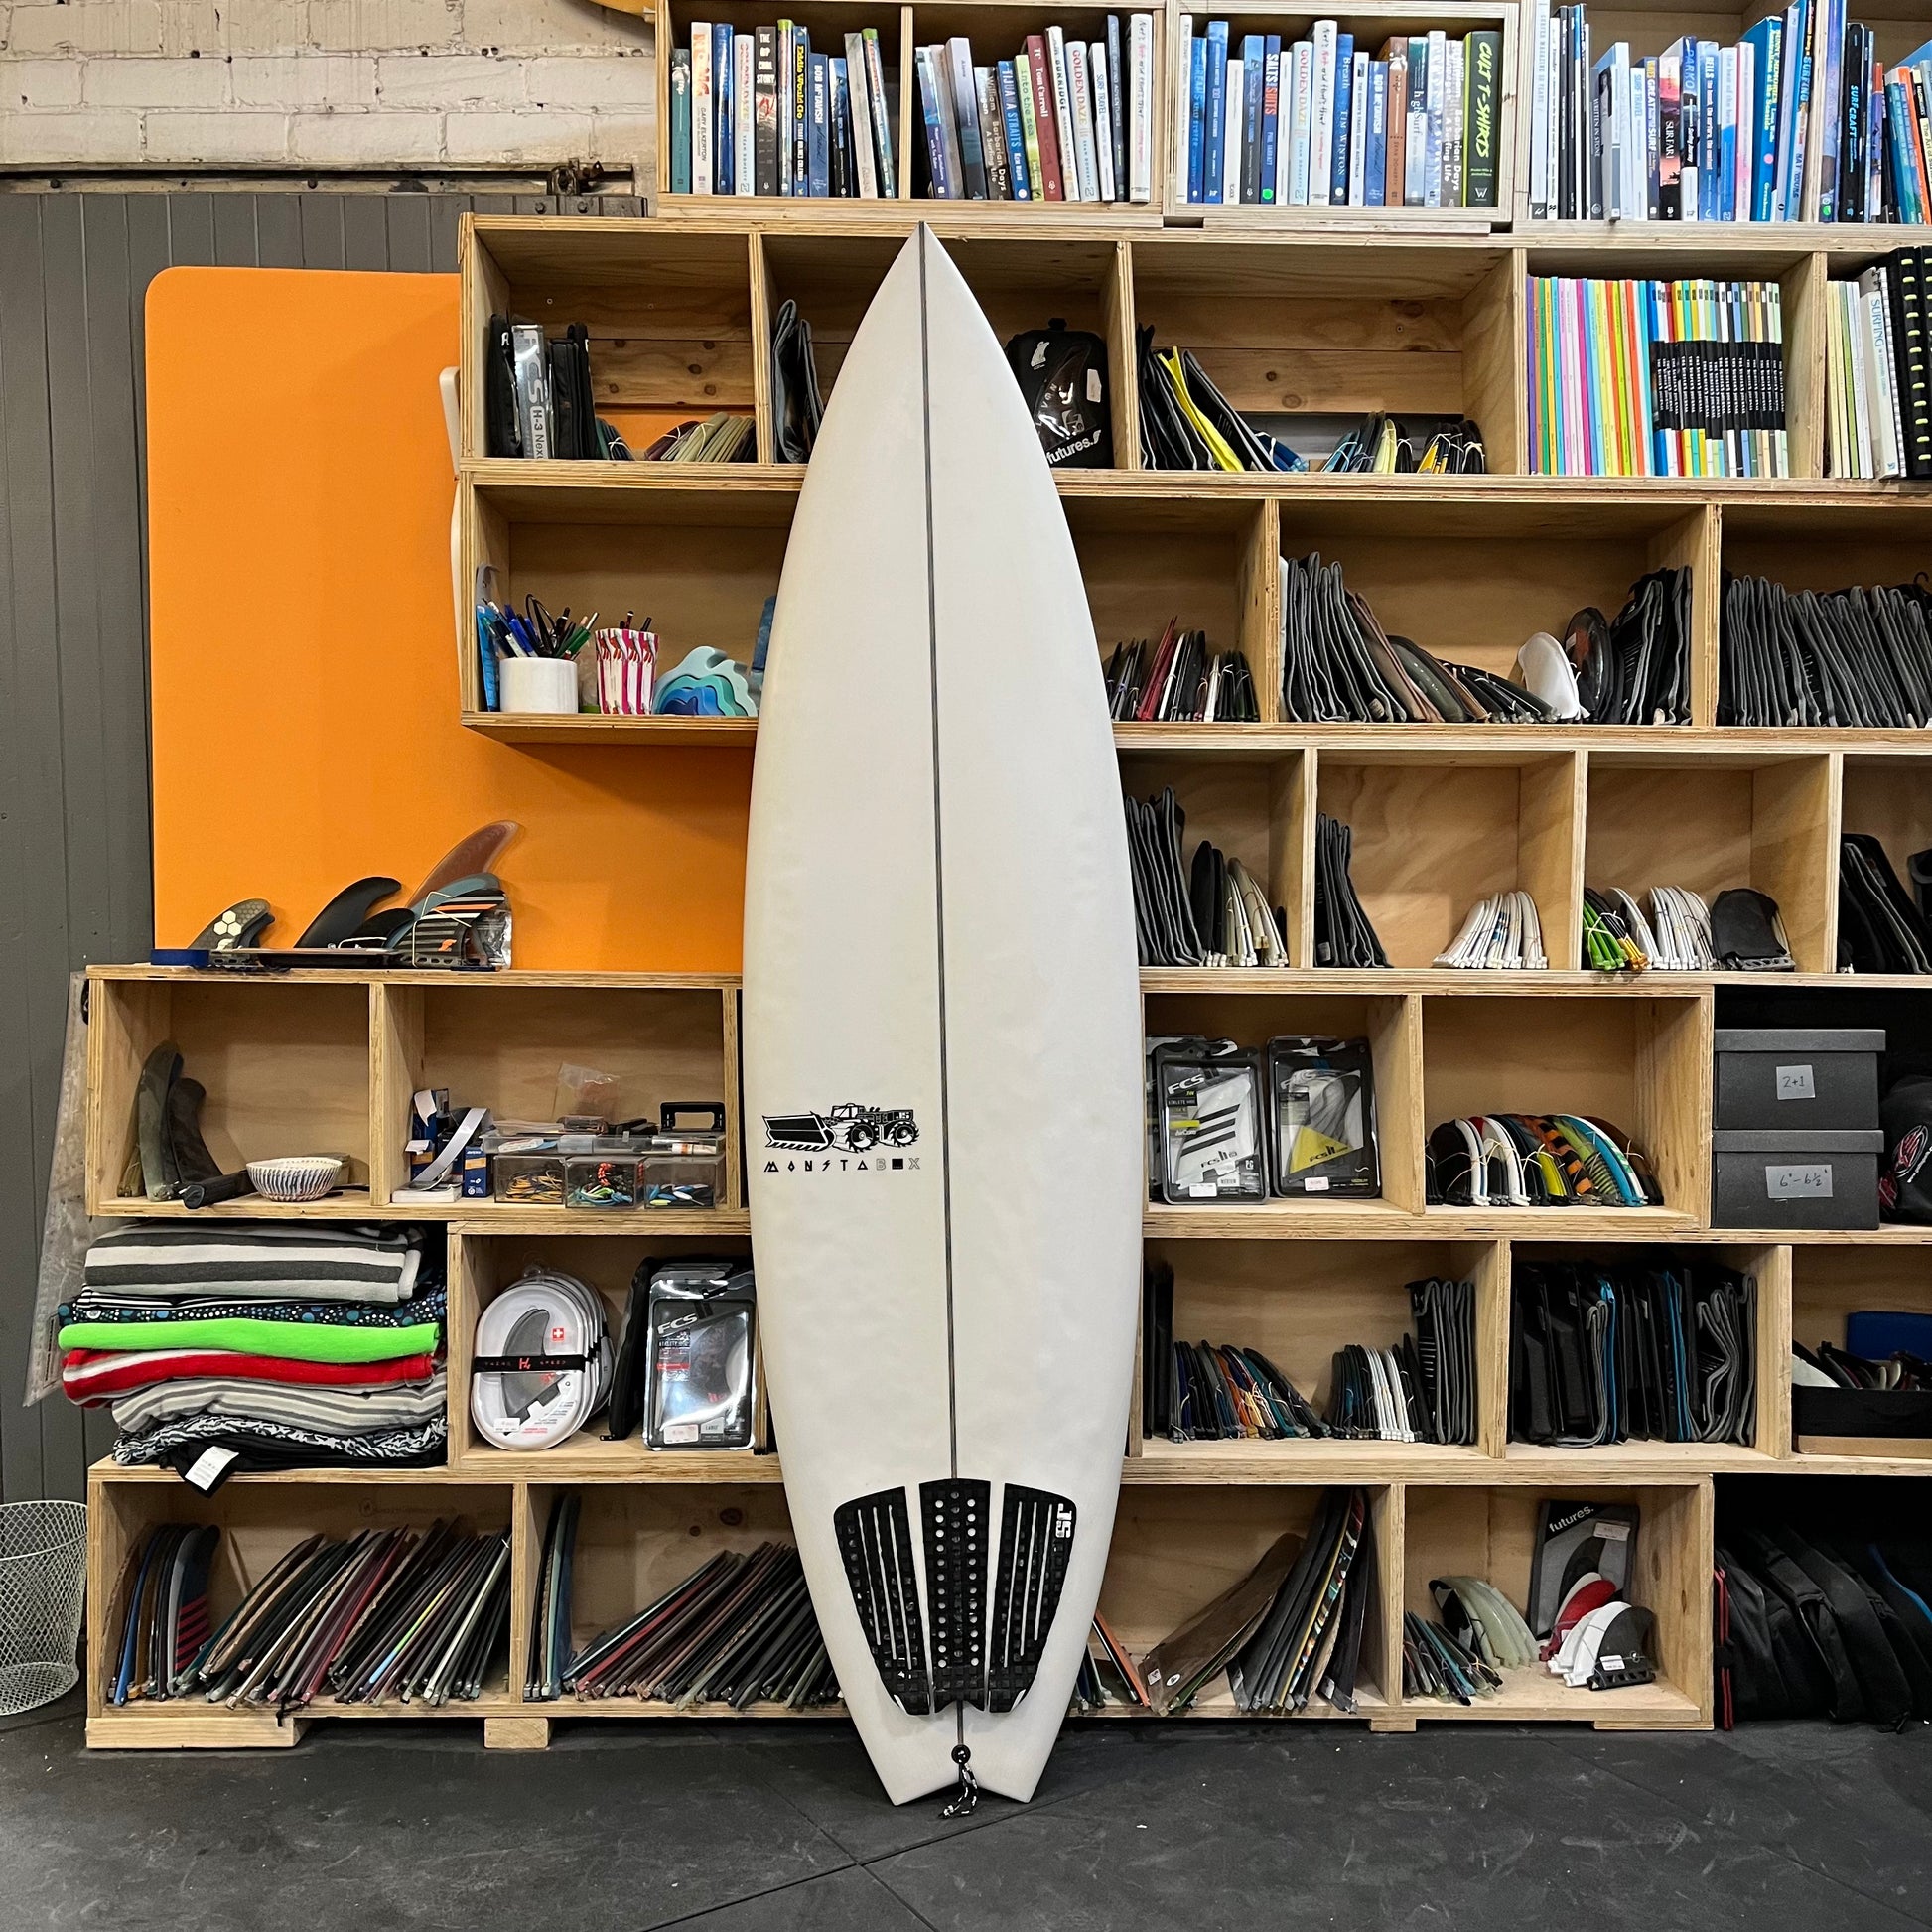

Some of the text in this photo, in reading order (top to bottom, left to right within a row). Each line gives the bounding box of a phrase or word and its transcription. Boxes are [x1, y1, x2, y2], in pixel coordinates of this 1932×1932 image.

[1477, 42, 1493, 82] CULT
[1684, 49, 1694, 89] PARKO
[1705, 56, 1714, 79] BELLS
[1800, 56, 1812, 101] SURFING
[987, 75, 996, 111] William
[1037, 86, 1048, 117] Carroll
[1072, 50, 1088, 125] GOLDEN DAZE
[1265, 53, 1279, 115] SALTS SUITS
[1298, 49, 1309, 126] GOLDEN DAZE
[1374, 74, 1383, 92] BOB
[796, 104, 803, 119] Go
[1003, 69, 1021, 148] TIJUANA STRAITS
[1338, 57, 1351, 175] Breath TIM WINTON
[1475, 84, 1491, 158] T-SHIRTS
[1647, 79, 1657, 152] GREAT SURF
[1849, 85, 1859, 138] SURFCRAFT
[986, 138, 995, 166] Surfing
[992, 121, 1007, 191] Barbarian Days
[1443, 126, 1452, 161] Surfing
[1452, 109, 1462, 191] Barbarian Days
[1665, 121, 1674, 159] SURFARI
[1871, 299, 1884, 346] SURFING
[533, 409, 542, 430] H-3
[1046, 437, 1094, 465] futures.
[1168, 1074, 1204, 1094] FCS
[1782, 1075, 1805, 1088] 2+1
[657, 1313, 698, 1335] FCS
[1055, 1503, 1073, 1538] JS
[1549, 1505, 1594, 1533] futures.
